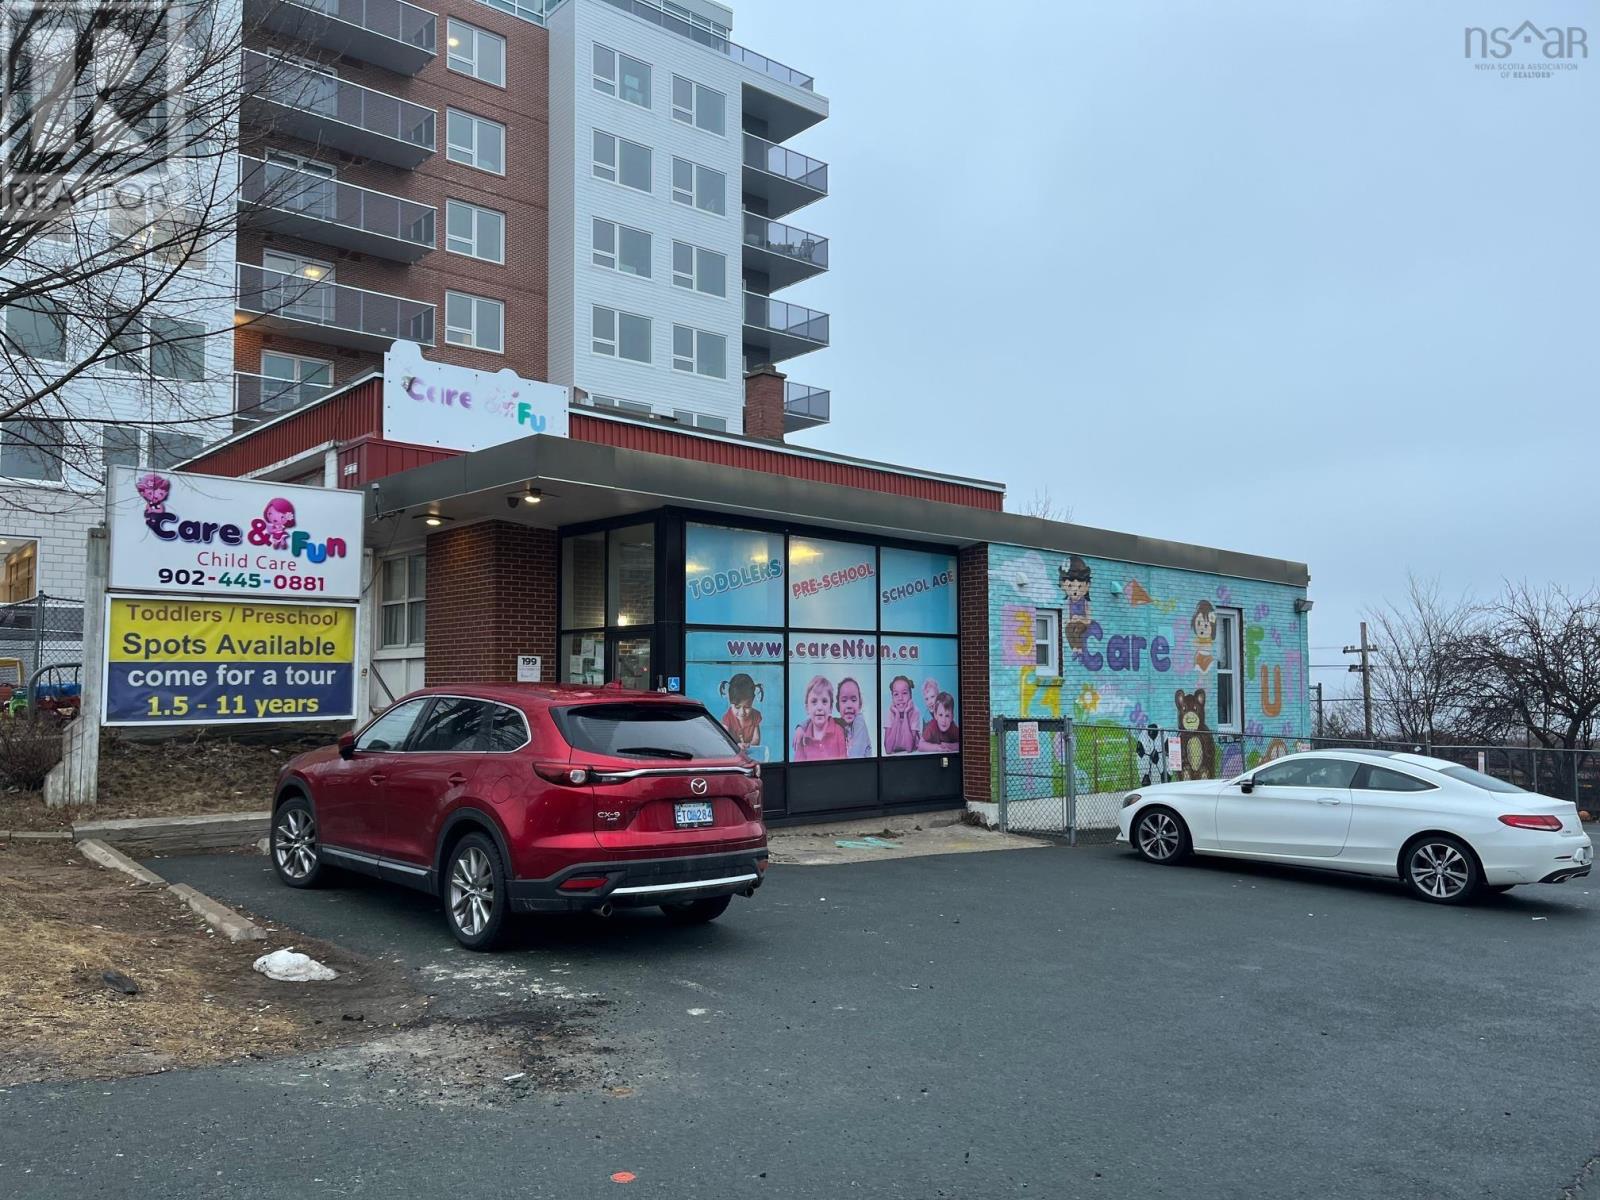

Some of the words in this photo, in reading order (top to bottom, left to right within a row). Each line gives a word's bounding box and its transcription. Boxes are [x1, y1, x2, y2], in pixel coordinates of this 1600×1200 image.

[150, 511, 242, 545] Care
[247, 518, 272, 547] &
[291, 530, 347, 563] Fun
[196, 551, 248, 569] Child
[256, 555, 297, 571] Care
[158, 567, 325, 592] 902-445-0881
[688, 558, 784, 600] TODDLERS
[791, 562, 875, 599] PRE-SCHOOL
[881, 580, 930, 605] SCHOOL
[932, 570, 954, 588] AGE
[126, 603, 222, 623] Toddlers
[228, 606, 236, 622] /
[241, 606, 338, 627] Preschool
[122, 631, 207, 659] Spots
[216, 633, 336, 657] Available
[727, 637, 920, 660] www.careNfun.ca
[1081, 619, 1172, 673] Care
[522, 657, 537, 666] 199
[127, 669, 208, 687] come
[216, 663, 254, 686] for
[262, 669, 278, 686] a
[285, 667, 336, 686] tour
[147, 695, 189, 716] 1.5
[216, 694, 247, 715] 11
[254, 696, 319, 718] years
[597, 811, 621, 819] CX-9
[697, 808, 712, 820] 284
